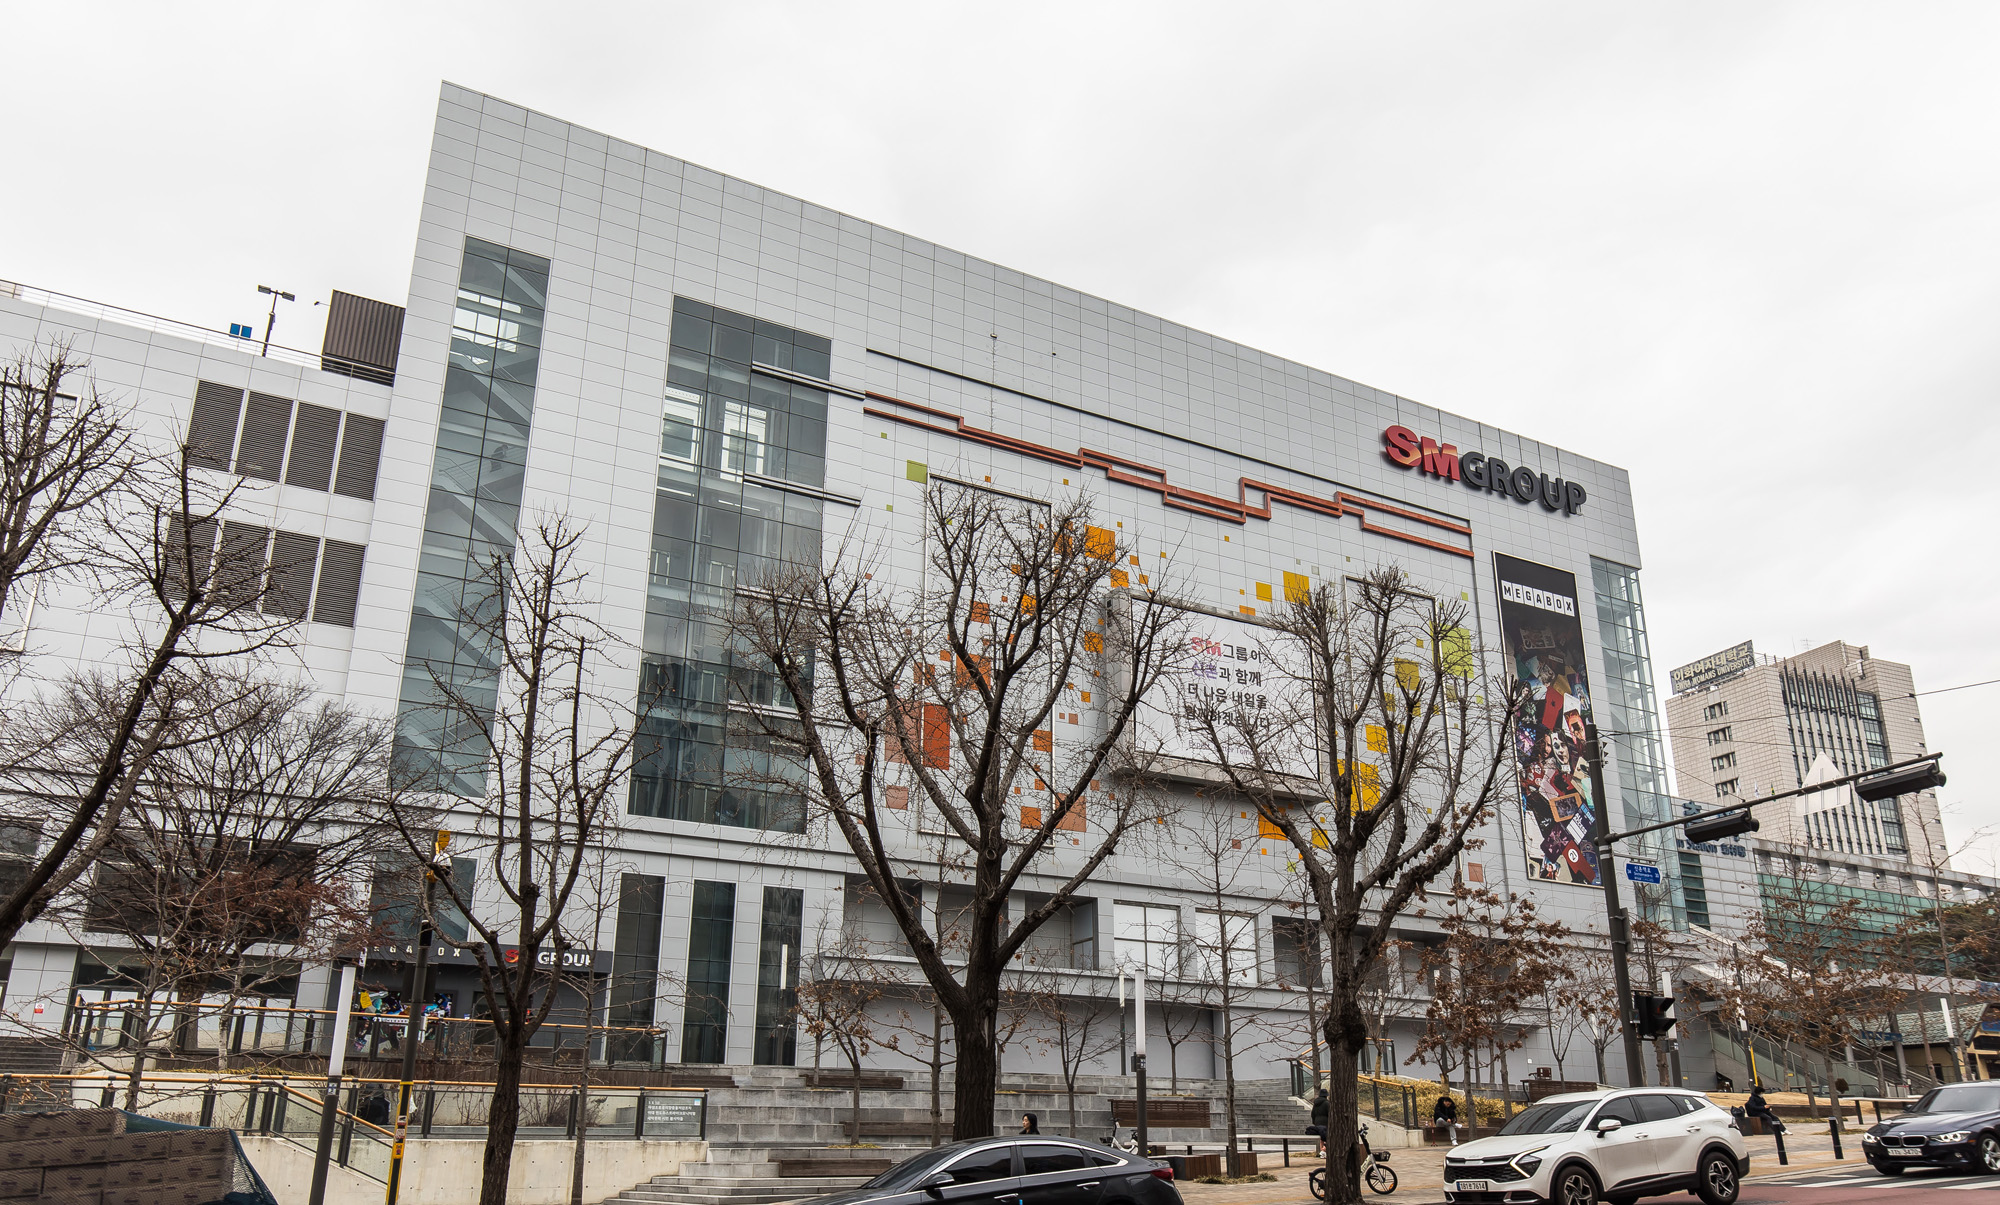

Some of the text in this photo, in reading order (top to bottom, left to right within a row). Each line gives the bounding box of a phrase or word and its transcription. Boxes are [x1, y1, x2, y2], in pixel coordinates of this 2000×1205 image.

[1503, 584, 1573, 612] MEGABOX
[1191, 636, 1262, 663] SM그룹이
[1673, 645, 1750, 680] 이화여자대학교
[1235, 668, 1262, 687] 함께
[1717, 656, 1752, 676] UNIVERSITY
[1188, 683, 1268, 709] 더 나은 내일을
